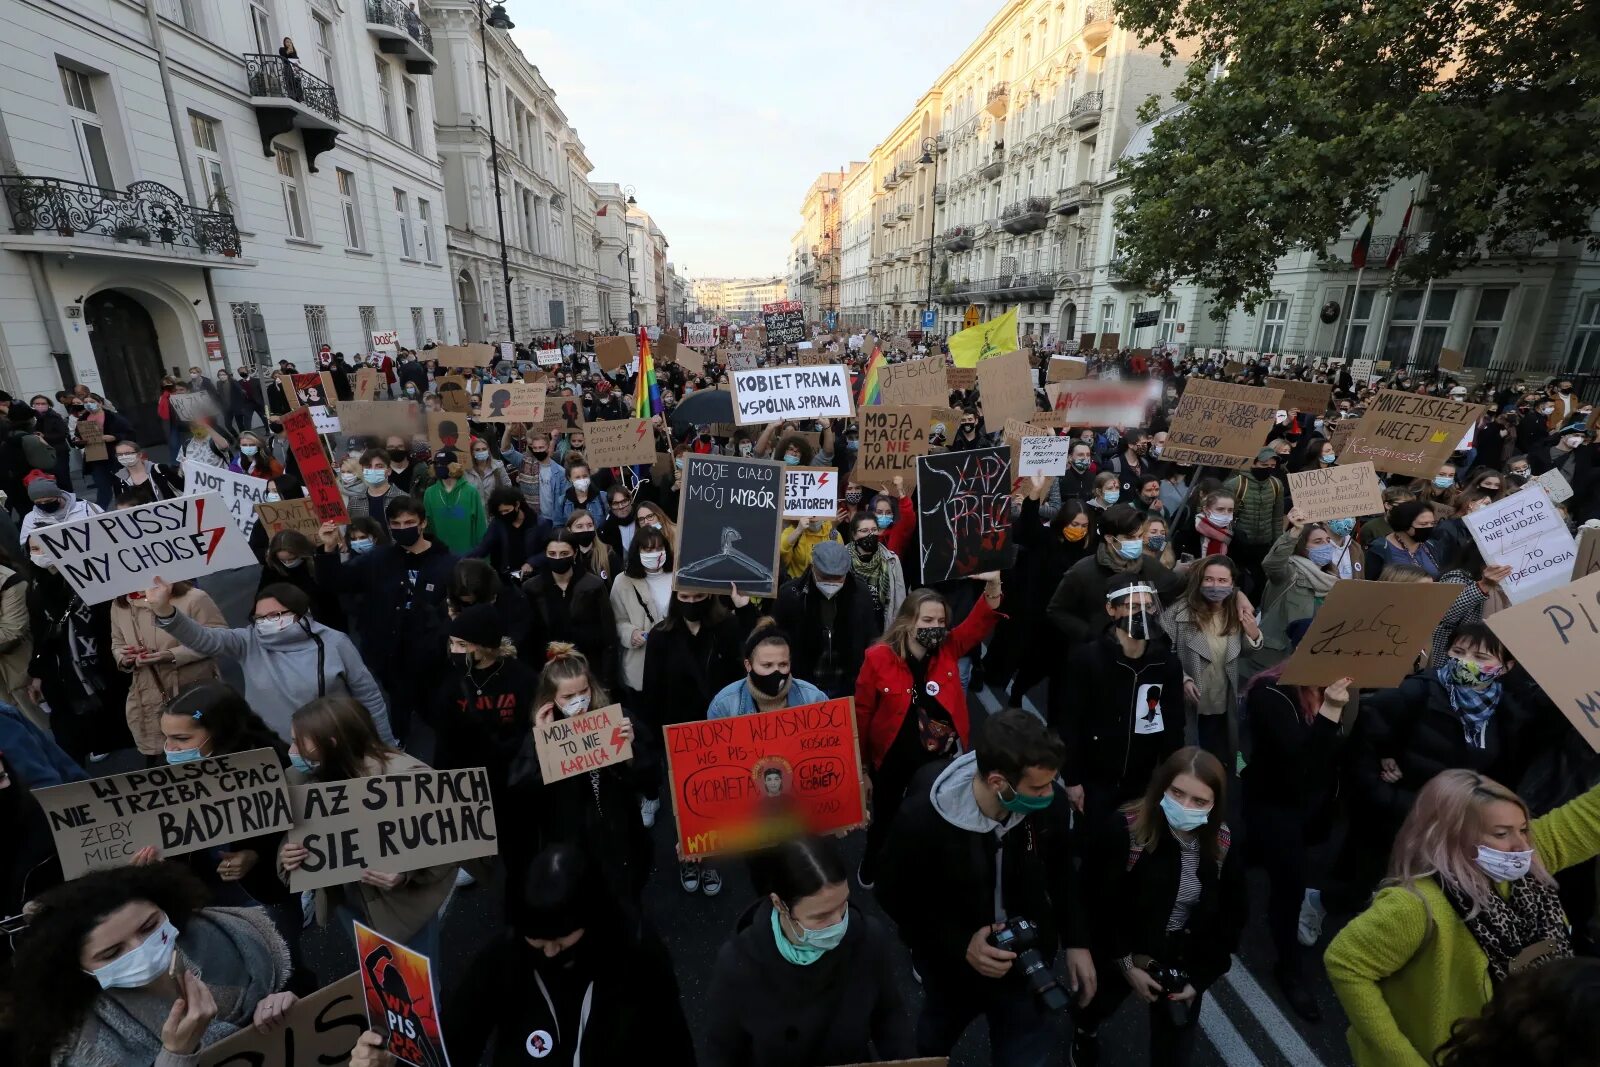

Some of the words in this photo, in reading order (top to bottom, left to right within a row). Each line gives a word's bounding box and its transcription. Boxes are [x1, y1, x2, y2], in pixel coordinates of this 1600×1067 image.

[70, 308, 80, 317] 37
[925, 312, 933, 323] P
[207, 323, 215, 333] 37
[736, 373, 792, 393] KOBIET
[794, 371, 842, 389] PRAWA
[739, 396, 796, 415] WSPÓLNA
[797, 395, 841, 410] SPRAWA
[1371, 392, 1421, 415] MNIEJ
[1417, 398, 1476, 422] KSIĘŻY
[864, 412, 913, 429] MOJA
[1375, 419, 1431, 443] WIĘCEJ
[863, 428, 924, 442] MACICA
[863, 443, 881, 454] TO
[886, 441, 911, 453] NIE
[194, 471, 225, 492] NOT
[691, 461, 729, 480] MOJE
[737, 466, 773, 480] CIAŁO
[689, 483, 724, 509] MÓJ
[730, 486, 776, 509] WYBÓR
[1478, 507, 1525, 533] KOBIETY
[1526, 500, 1544, 513] TO
[1484, 530, 1503, 543] NIE
[1505, 511, 1549, 534] LUDZIE.
[39, 522, 91, 560] MY
[97, 500, 188, 543] PUSSY
[64, 552, 111, 589] MY
[118, 532, 209, 573] CHOISE
[1508, 551, 1575, 583] IDEOLOGIA
[1525, 548, 1544, 560] TO
[543, 724, 573, 745] MOJA
[572, 711, 612, 735] MACICA
[668, 721, 734, 753] ZBIORY
[749, 703, 848, 742] WŁASNOŚCI
[559, 740, 578, 757] TO
[581, 732, 601, 751] NIE
[560, 747, 610, 775] KAPLICA
[696, 751, 718, 766] WG
[800, 762, 834, 779] CIAŁO
[89, 778, 120, 798] W
[125, 756, 237, 791] POLSCE
[49, 803, 97, 831] NIE
[103, 781, 213, 818] TRZEBA
[303, 785, 350, 819] AŻ
[362, 770, 490, 811] STRACH
[158, 787, 294, 850] BADTRIPA
[299, 828, 369, 873] SIĘ
[377, 800, 497, 858] RUCHAĆ
[84, 839, 136, 865] MIEĆ
[387, 1009, 416, 1040] PIS
